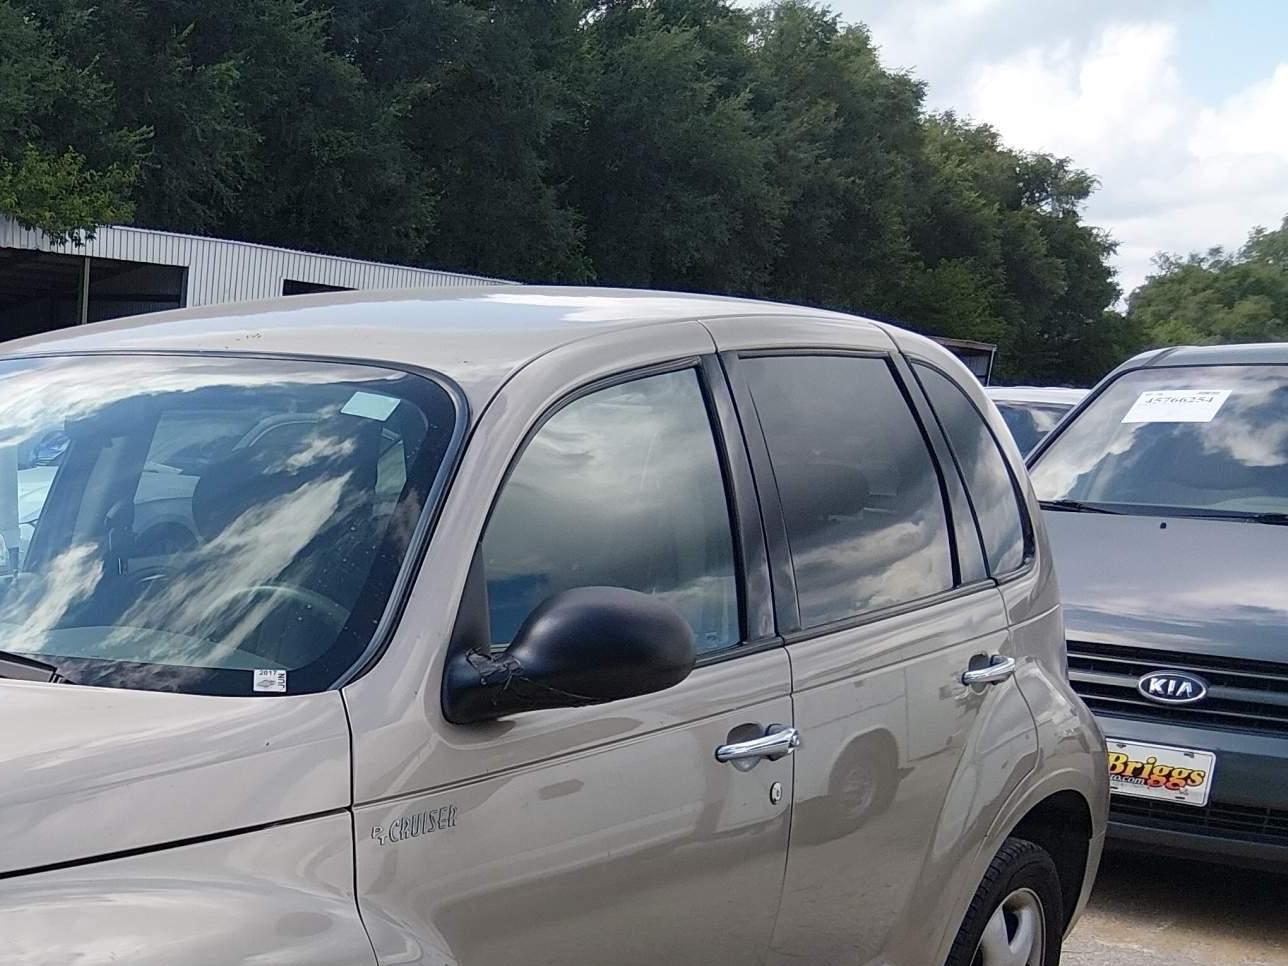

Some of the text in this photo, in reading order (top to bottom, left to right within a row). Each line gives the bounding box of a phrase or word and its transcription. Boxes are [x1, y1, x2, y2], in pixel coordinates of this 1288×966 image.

[277, 673, 286, 688] JUN
[1149, 678, 1193, 697] KIA
[1108, 751, 1206, 790] Briggs
[371, 805, 457, 846] PT CRUISER
